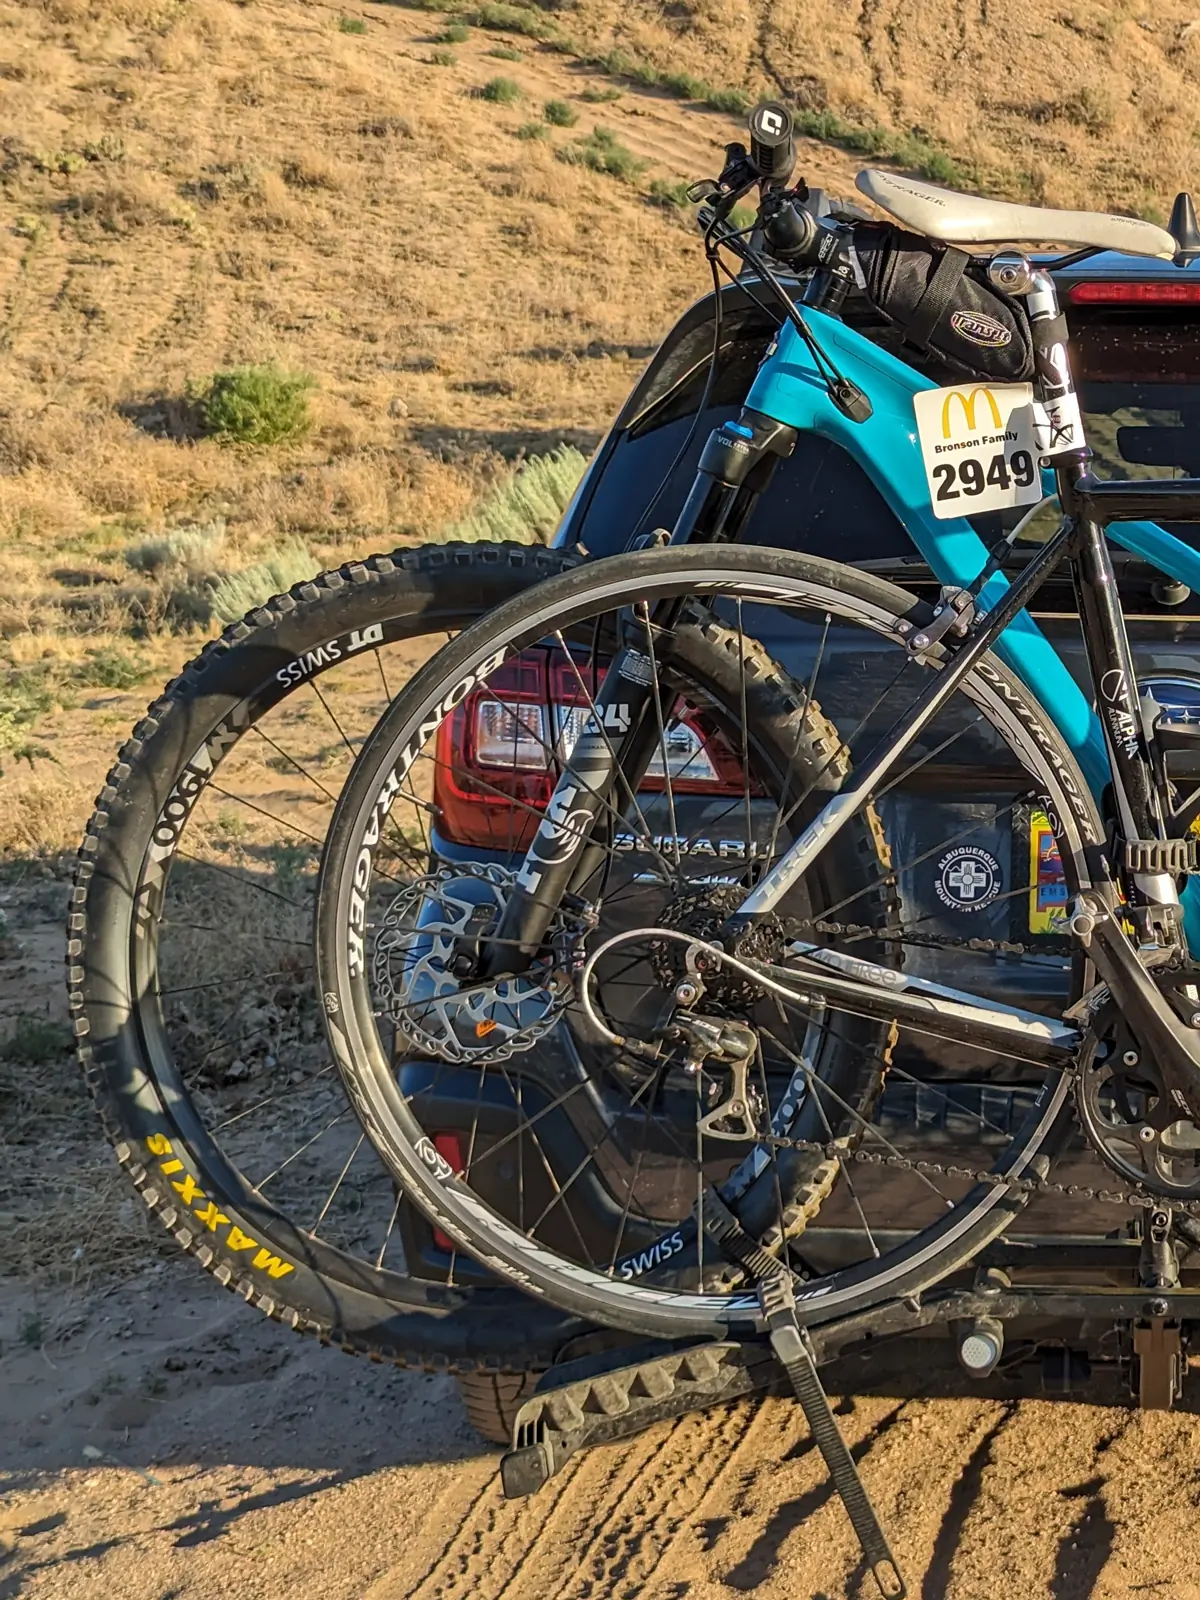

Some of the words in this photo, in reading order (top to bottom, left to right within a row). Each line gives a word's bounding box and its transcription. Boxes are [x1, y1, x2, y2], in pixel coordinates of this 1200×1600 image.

[875, 170, 947, 208] ONTRAGER
[935, 439, 980, 454] Bronson
[982, 431, 1019, 448] Family
[932, 450, 1035, 501] 2949
[346, 623, 385, 652] DT
[275, 639, 342, 689] SWISS
[1114, 708, 1141, 760] ALPHA
[348, 645, 510, 972] BONTRAGER
[755, 805, 839, 901] TREK
[937, 846, 1000, 872] ALBUQUERQUE
[1039, 886, 1067, 898] EMS
[146, 1132, 296, 1280] MAXXIS
[620, 1231, 685, 1281] SWISS
